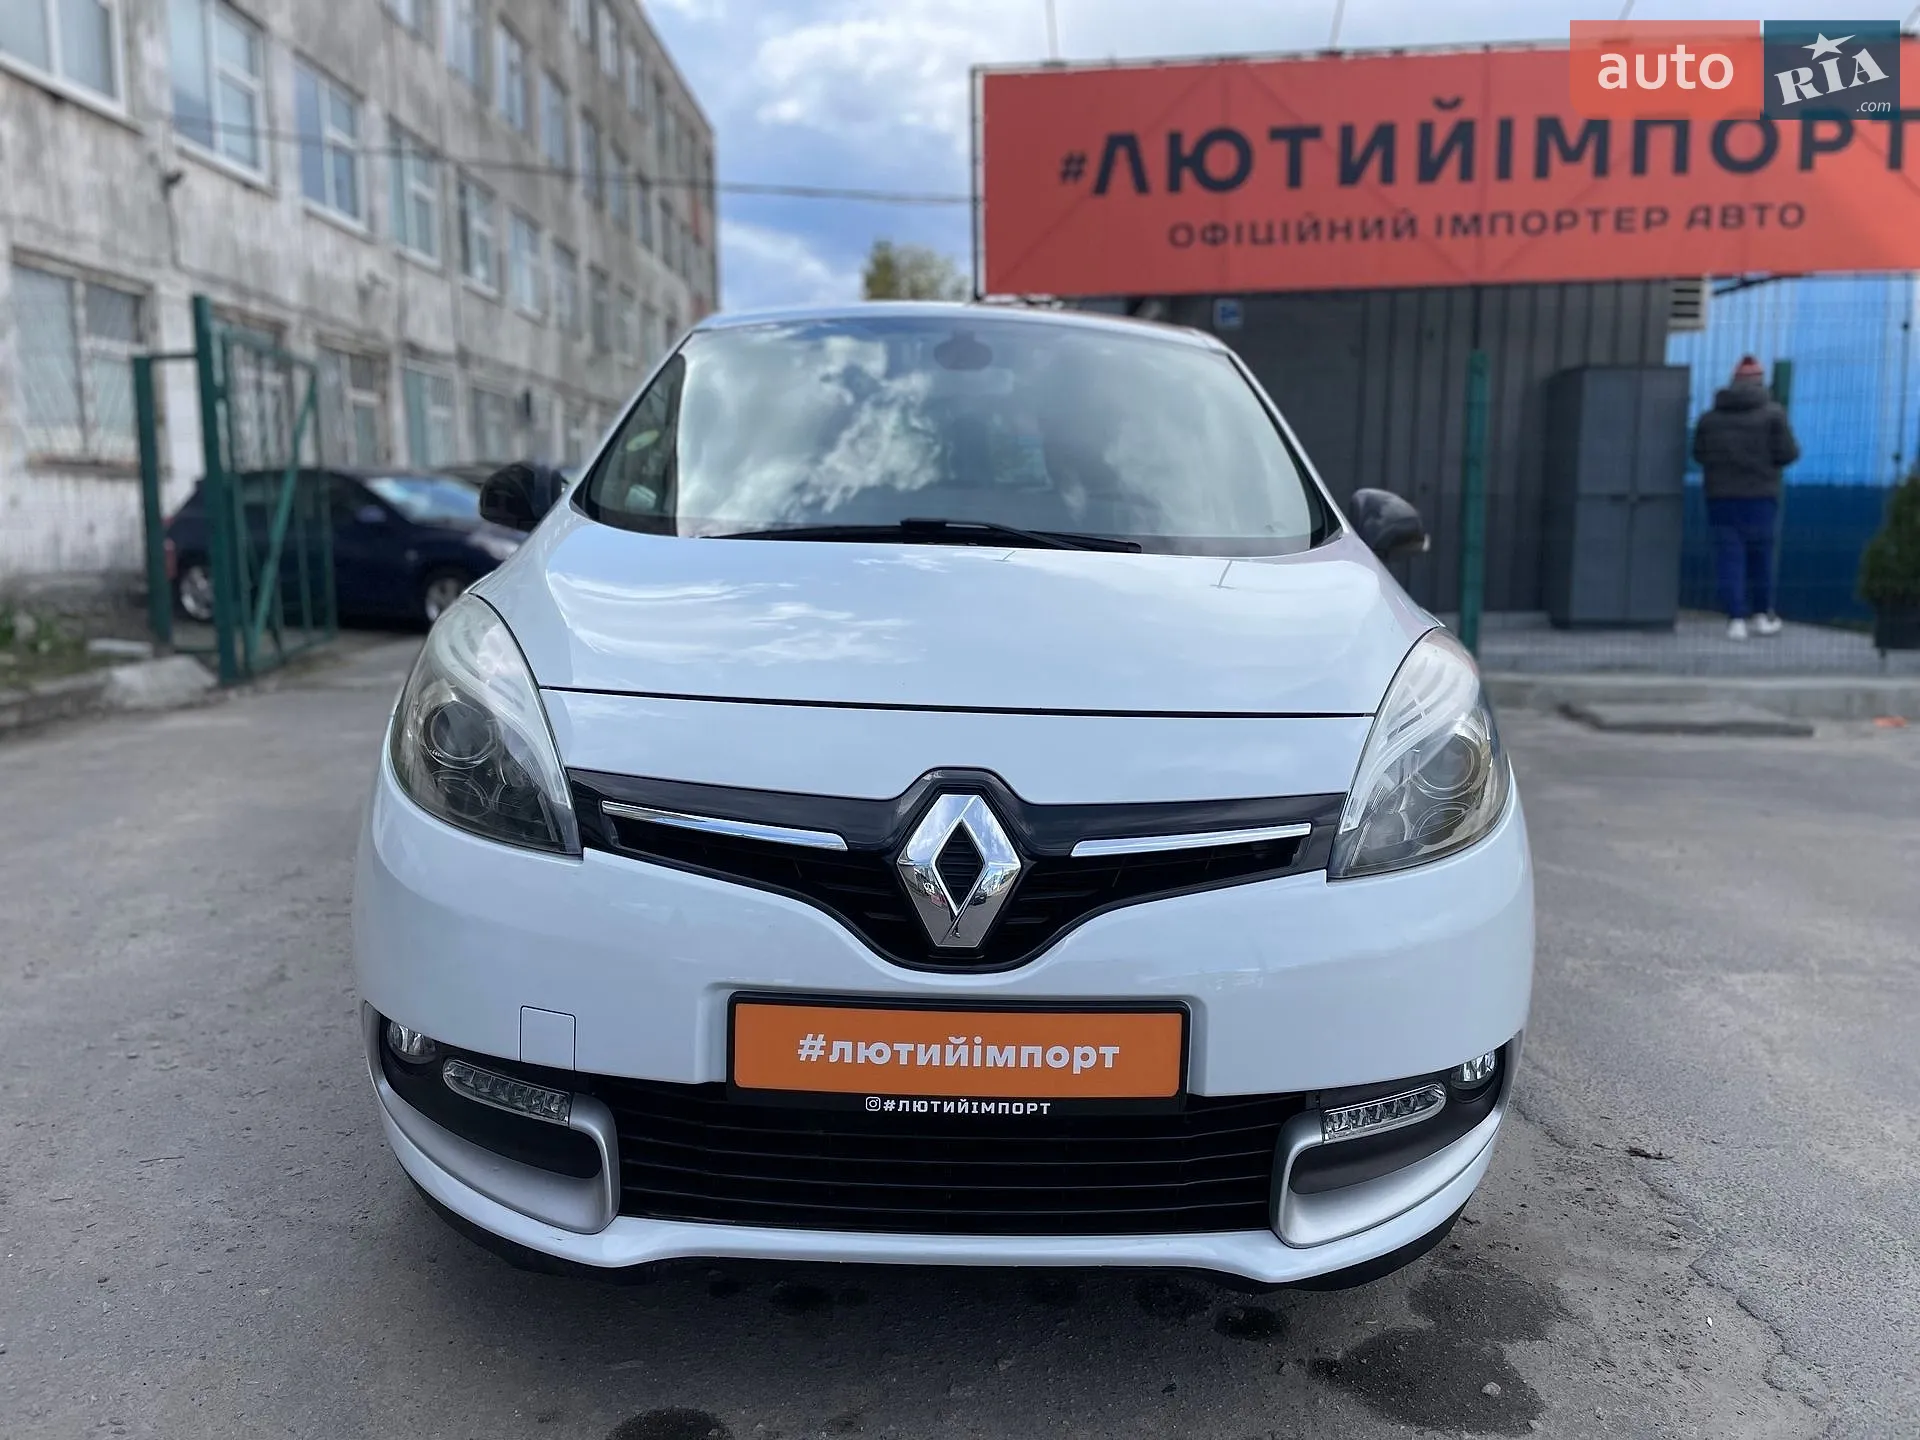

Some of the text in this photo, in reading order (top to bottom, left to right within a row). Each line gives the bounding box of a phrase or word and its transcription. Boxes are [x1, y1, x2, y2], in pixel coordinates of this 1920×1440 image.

[1168, 202, 1806, 248] ОФІЦІЙНИЙ ІМПОРТЕР АВТО
[797, 1033, 1120, 1074] #лютийімпорт
[883, 1098, 1051, 1115] #ЛЮТИЙІМПОРТ
